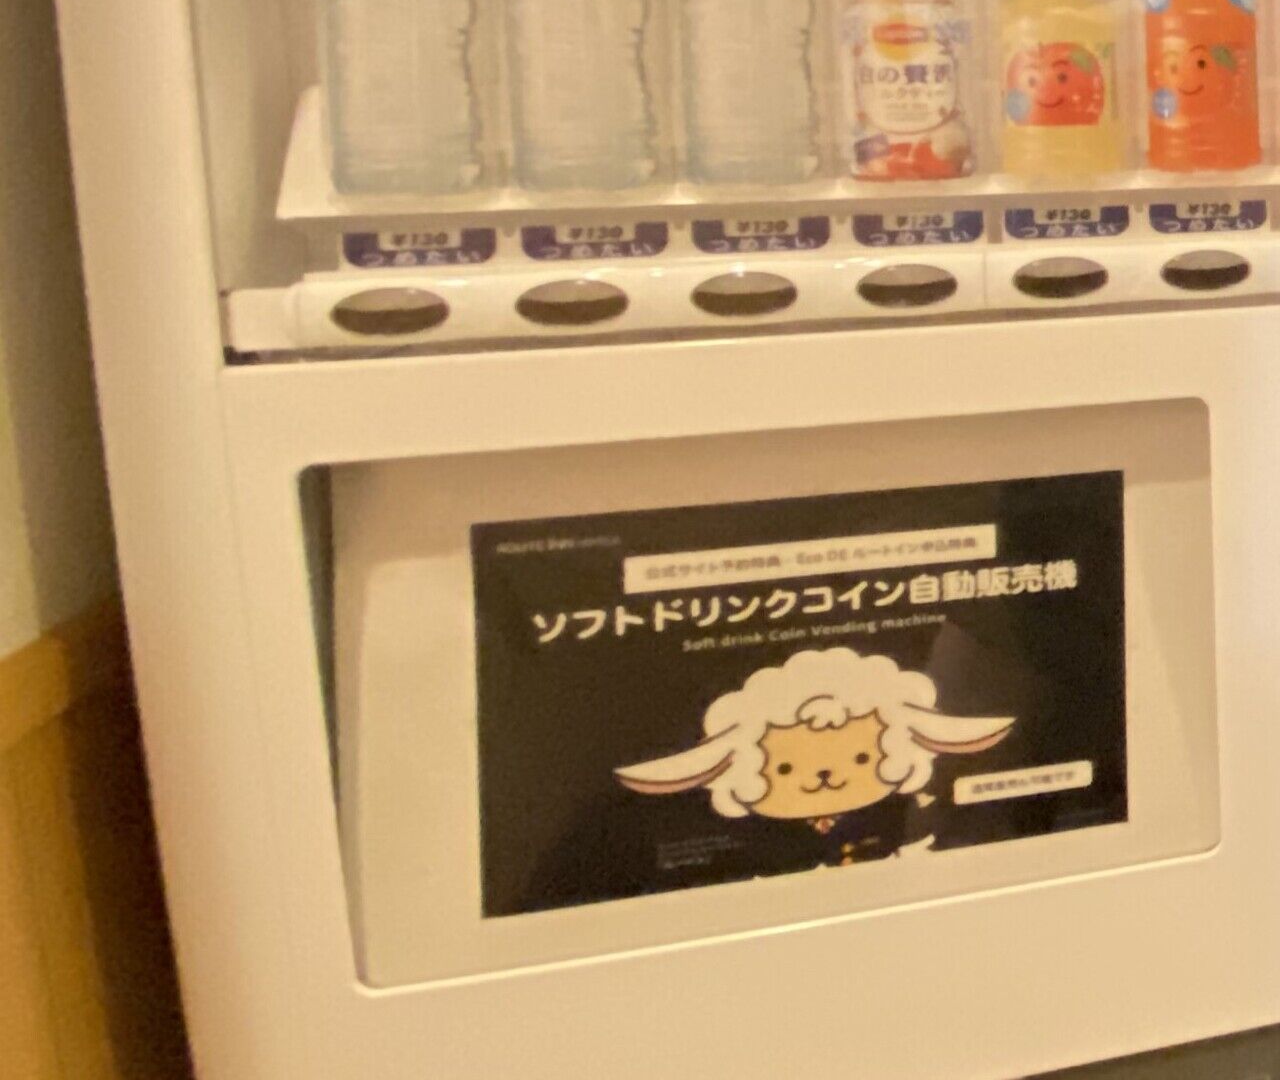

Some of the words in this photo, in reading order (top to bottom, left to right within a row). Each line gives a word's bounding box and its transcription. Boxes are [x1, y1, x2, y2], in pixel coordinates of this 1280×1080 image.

[532, 559, 1078, 644] ソフトドリンクコイン自動販売機
